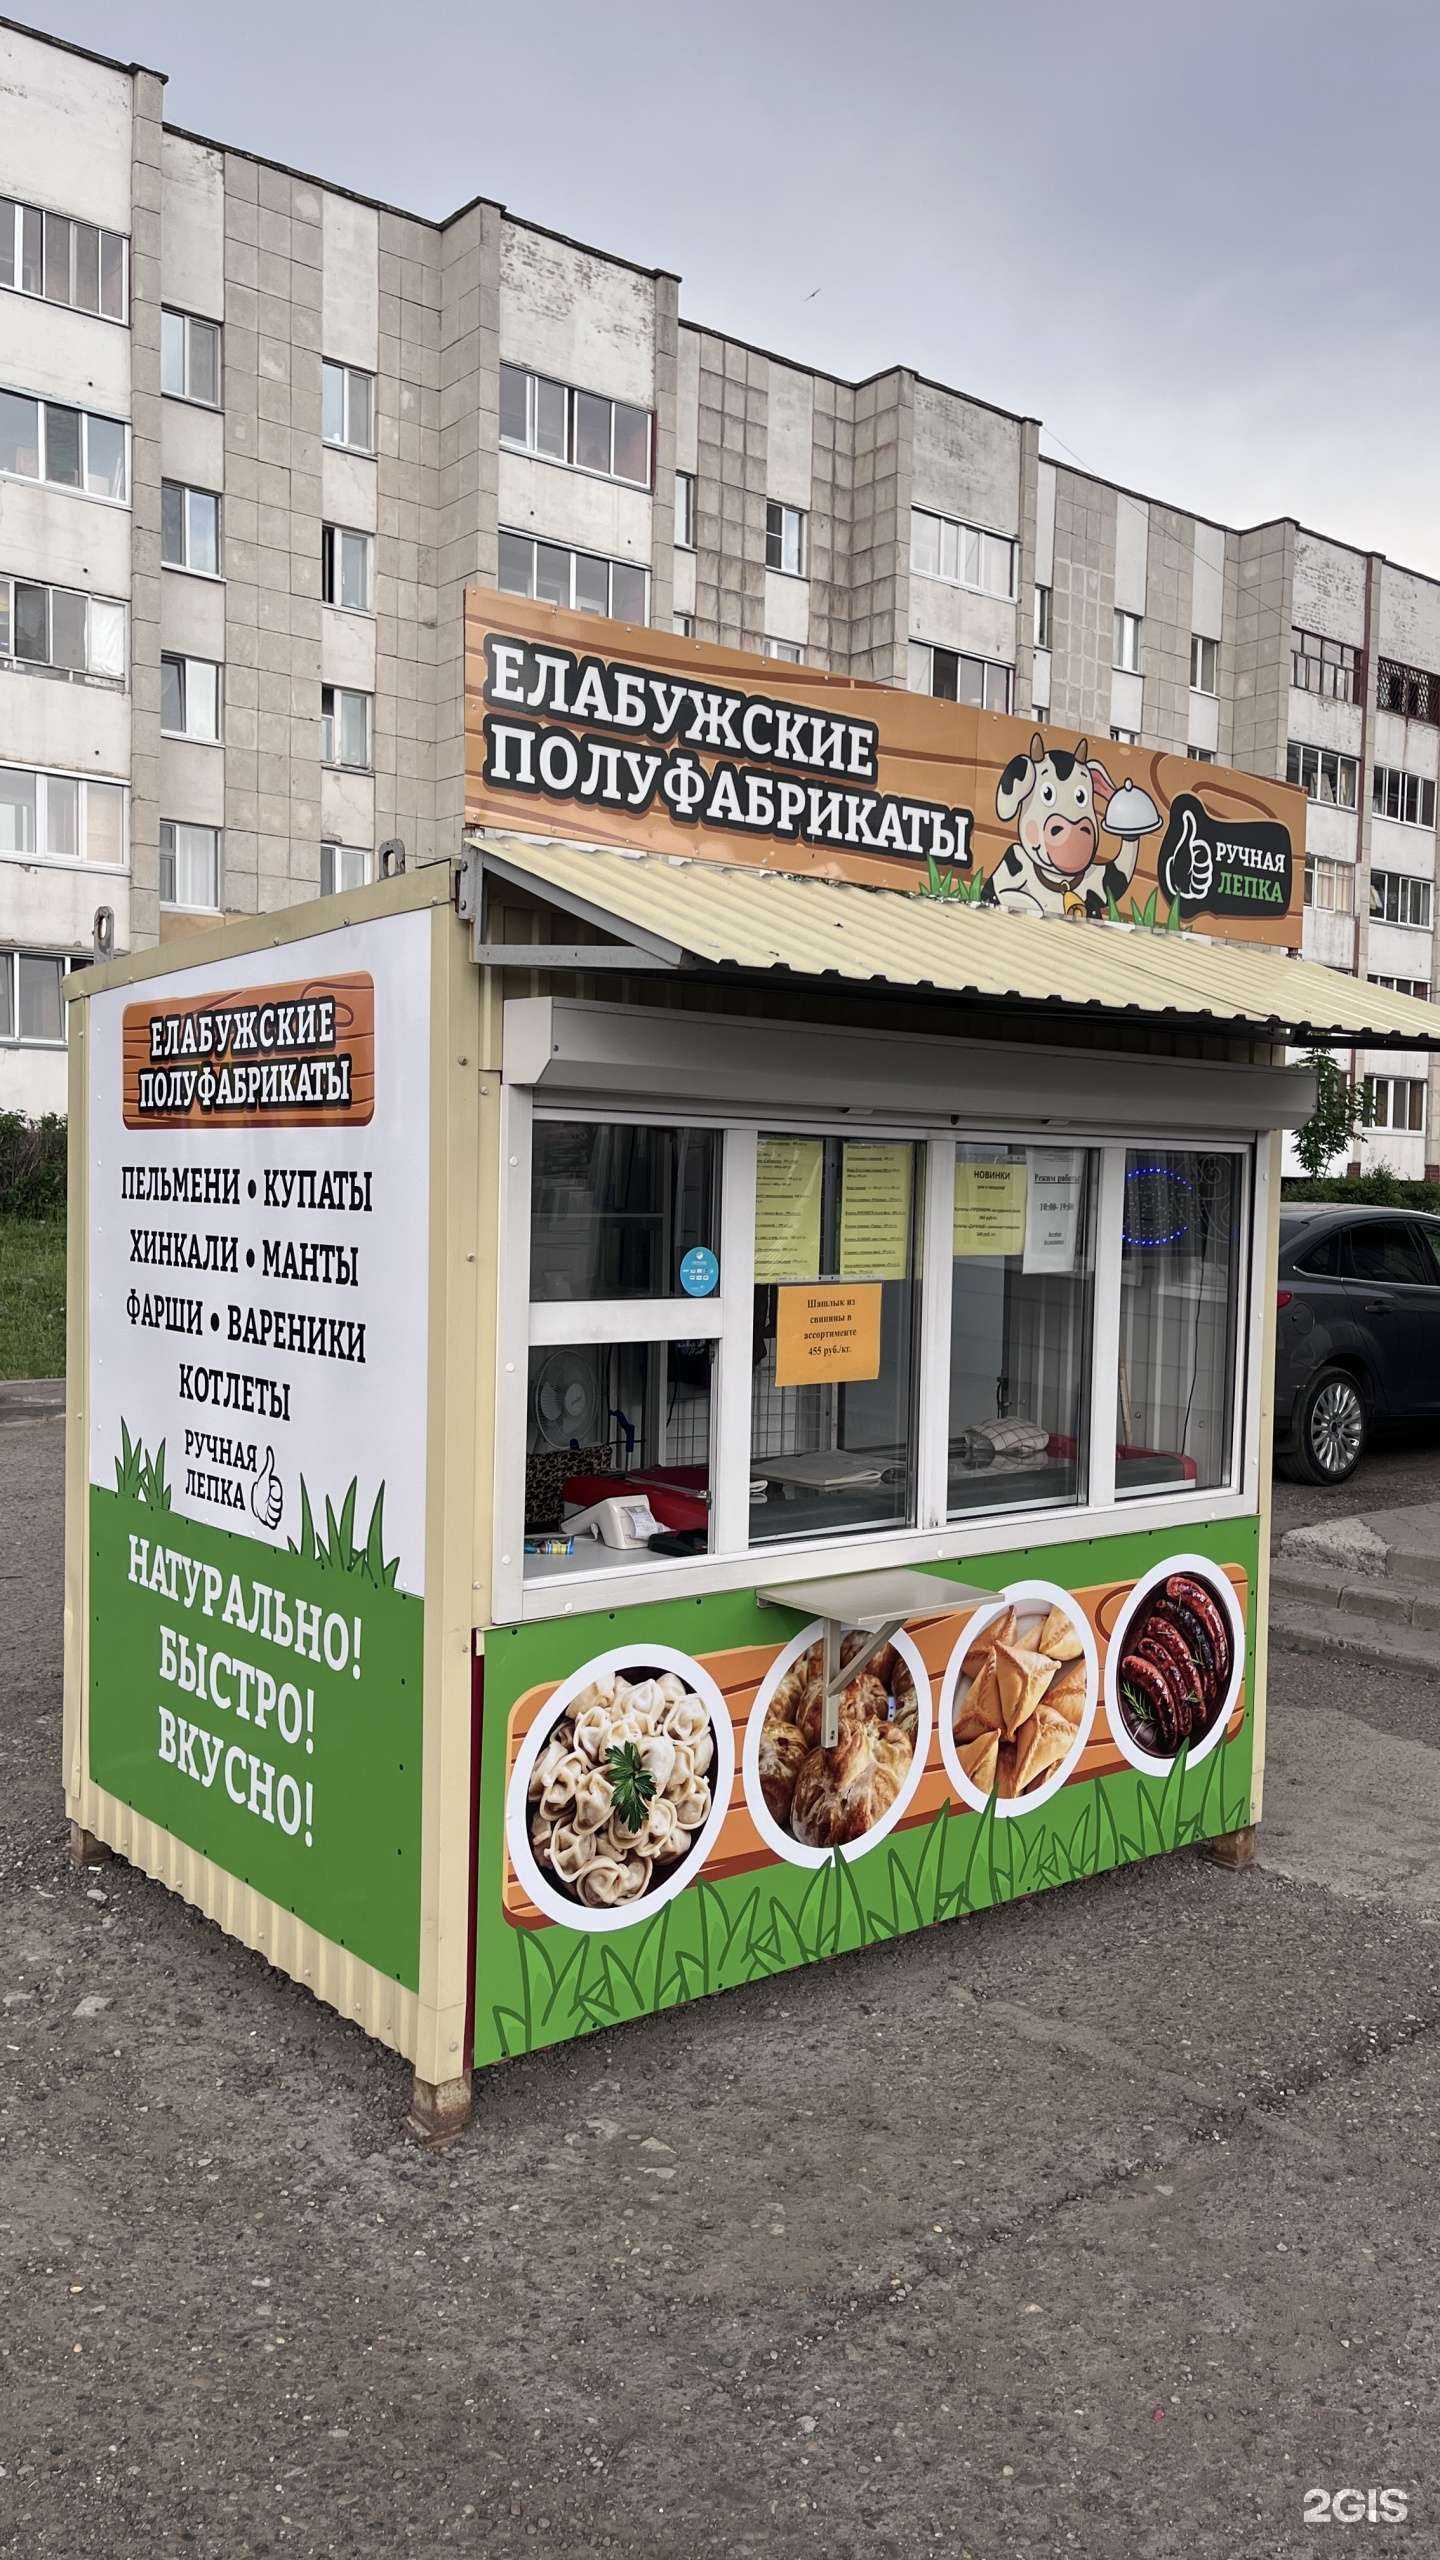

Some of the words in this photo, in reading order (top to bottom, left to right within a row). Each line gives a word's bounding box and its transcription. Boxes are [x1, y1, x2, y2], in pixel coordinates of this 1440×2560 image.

[490, 643, 874, 778] ЕЛАБУЖСКИЕ
[489, 722, 969, 863] ПОЛУФАБРИКАТЫ
[1215, 841, 1286, 873] РУЧНАЯ
[1217, 871, 1284, 904] ЛЕПКА
[151, 1001, 335, 1057] ЕЛАБУЖСКИЕ
[139, 1059, 351, 1108] ПОЛУФАБРИКАТЫ
[121, 1166, 240, 1205] ПЕЛЬМЕНИ
[263, 1169, 373, 1212] КУПАТЫ
[974, 1170, 1011, 1180] НОВИНКИ
[130, 1229, 239, 1273] ХИНКАЛИ
[262, 1239, 359, 1287] МАНТЫ
[126, 1288, 203, 1336] ФАРШИ
[227, 1304, 366, 1364] ВАРЕНИКИ
[807, 1299, 845, 1308] Шашлык
[809, 1314, 845, 1324] свинины
[803, 1328, 857, 1341] ассортименте
[808, 1346, 822, 1356] 455
[179, 1363, 291, 1421] КОТЛЕТЫ
[185, 1429, 257, 1473] РУЧНАЯ
[185, 1468, 246, 1511] ЛЕПКА
[128, 1534, 362, 1680] НАТУРАЛЬНО!
[159, 1625, 315, 1754] БЫСТРО!
[158, 1705, 314, 1847] ВКУСНО!
